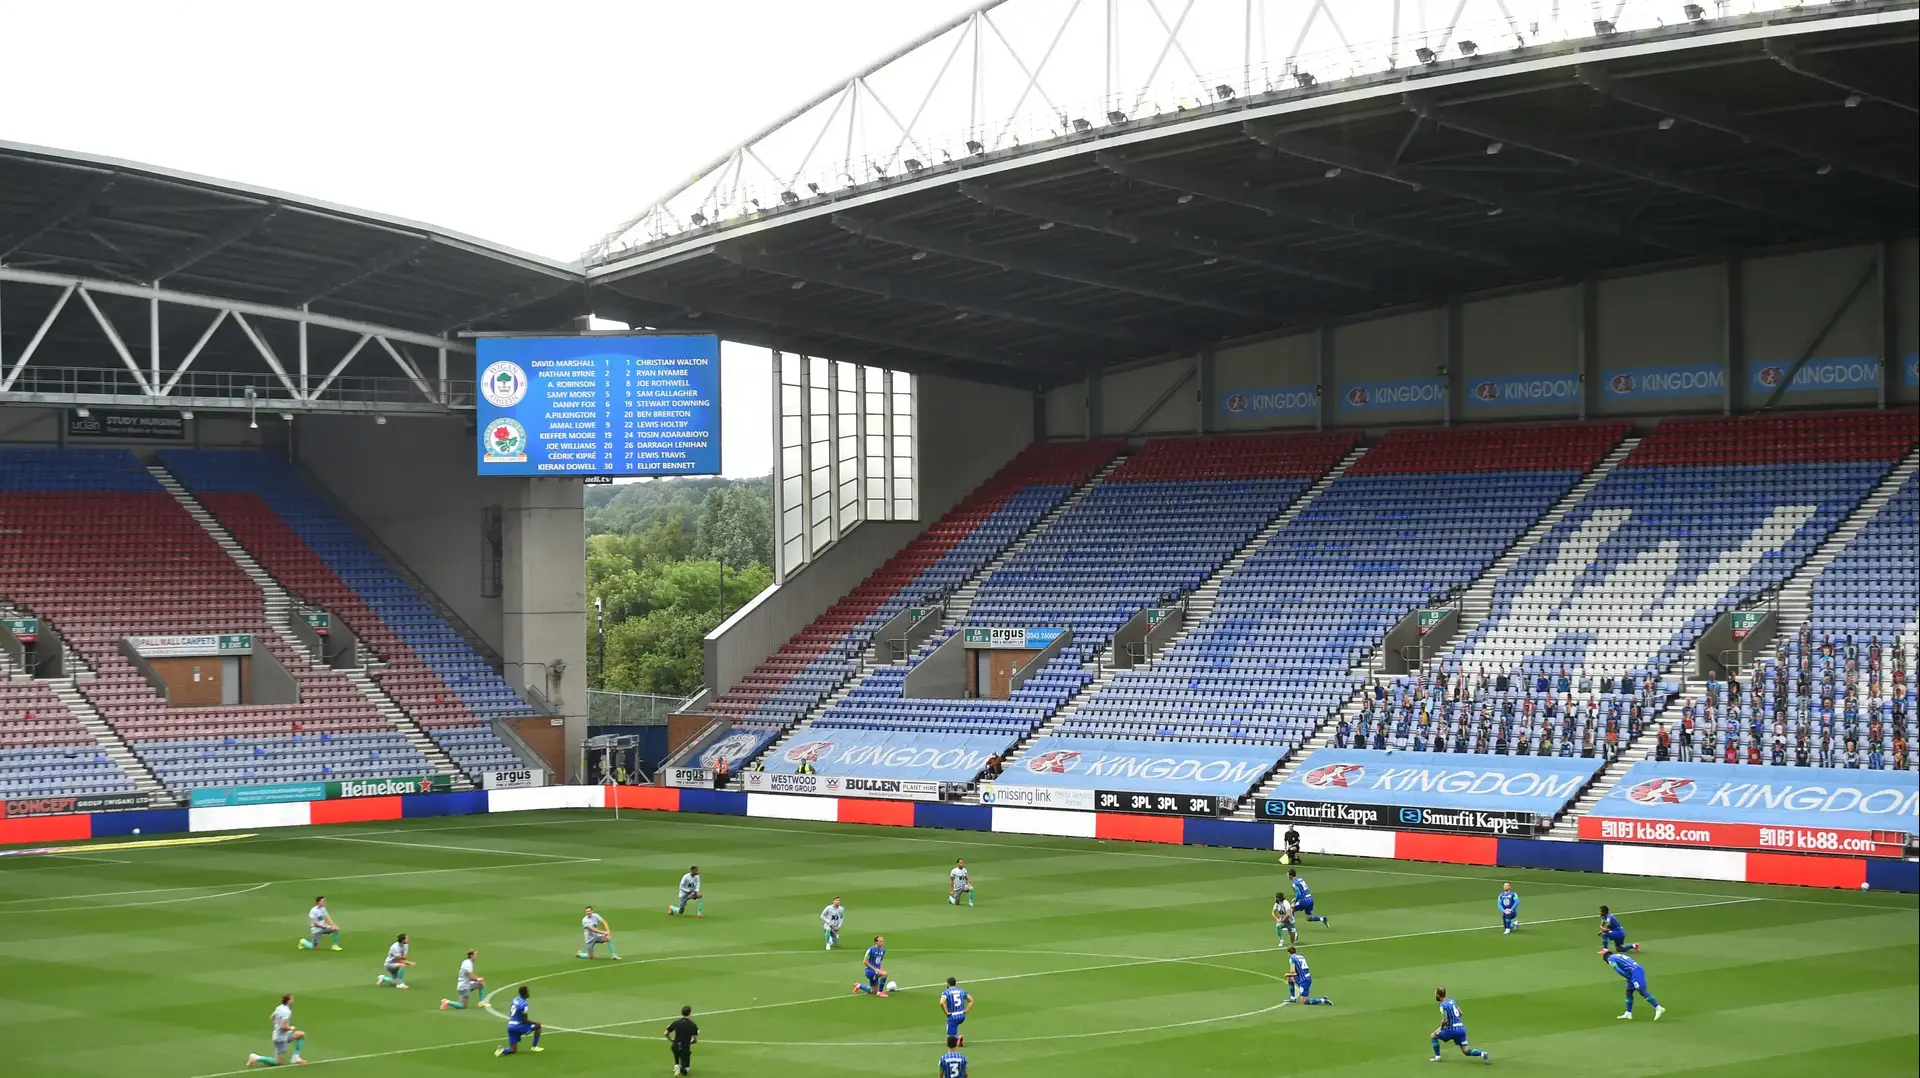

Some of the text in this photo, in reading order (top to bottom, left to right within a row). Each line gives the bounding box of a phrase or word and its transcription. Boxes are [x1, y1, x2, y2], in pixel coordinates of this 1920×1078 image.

[652, 379, 690, 387] ROTHWELL
[1642, 369, 1724, 391] KINGDOM
[106, 417, 137, 425] STUDY
[576, 451, 597, 459] KIPRÉ
[585, 475, 611, 483] adi.tv
[182, 637, 216, 645] CARPETS
[993, 630, 1024, 640] argus
[834, 744, 997, 770] KINGDOM
[496, 771, 531, 782] argus
[676, 769, 704, 781] argus
[1085, 756, 1268, 783] KINGDOM
[771, 775, 816, 784] WESTWOOD
[845, 779, 900, 792] BULLEN
[1372, 768, 1584, 798] KINGDOM
[340, 780, 415, 797] Heineken
[997, 789, 1051, 803] missing link
[1100, 794, 1210, 812] 3PL 3PL 3PL 3PL
[7, 798, 77, 814] CONCEPT
[1287, 802, 1377, 825] Smurfit Kappa
[1423, 809, 1518, 834] Smurfit Kappa
[1637, 822, 1710, 842] kb88.com
[1798, 831, 1875, 851] kb88.com
[953, 993, 961, 1007] 5
[511, 1004, 516, 1017] 9
[1453, 1004, 1460, 1017] 6
[950, 1063, 959, 1078] 3
